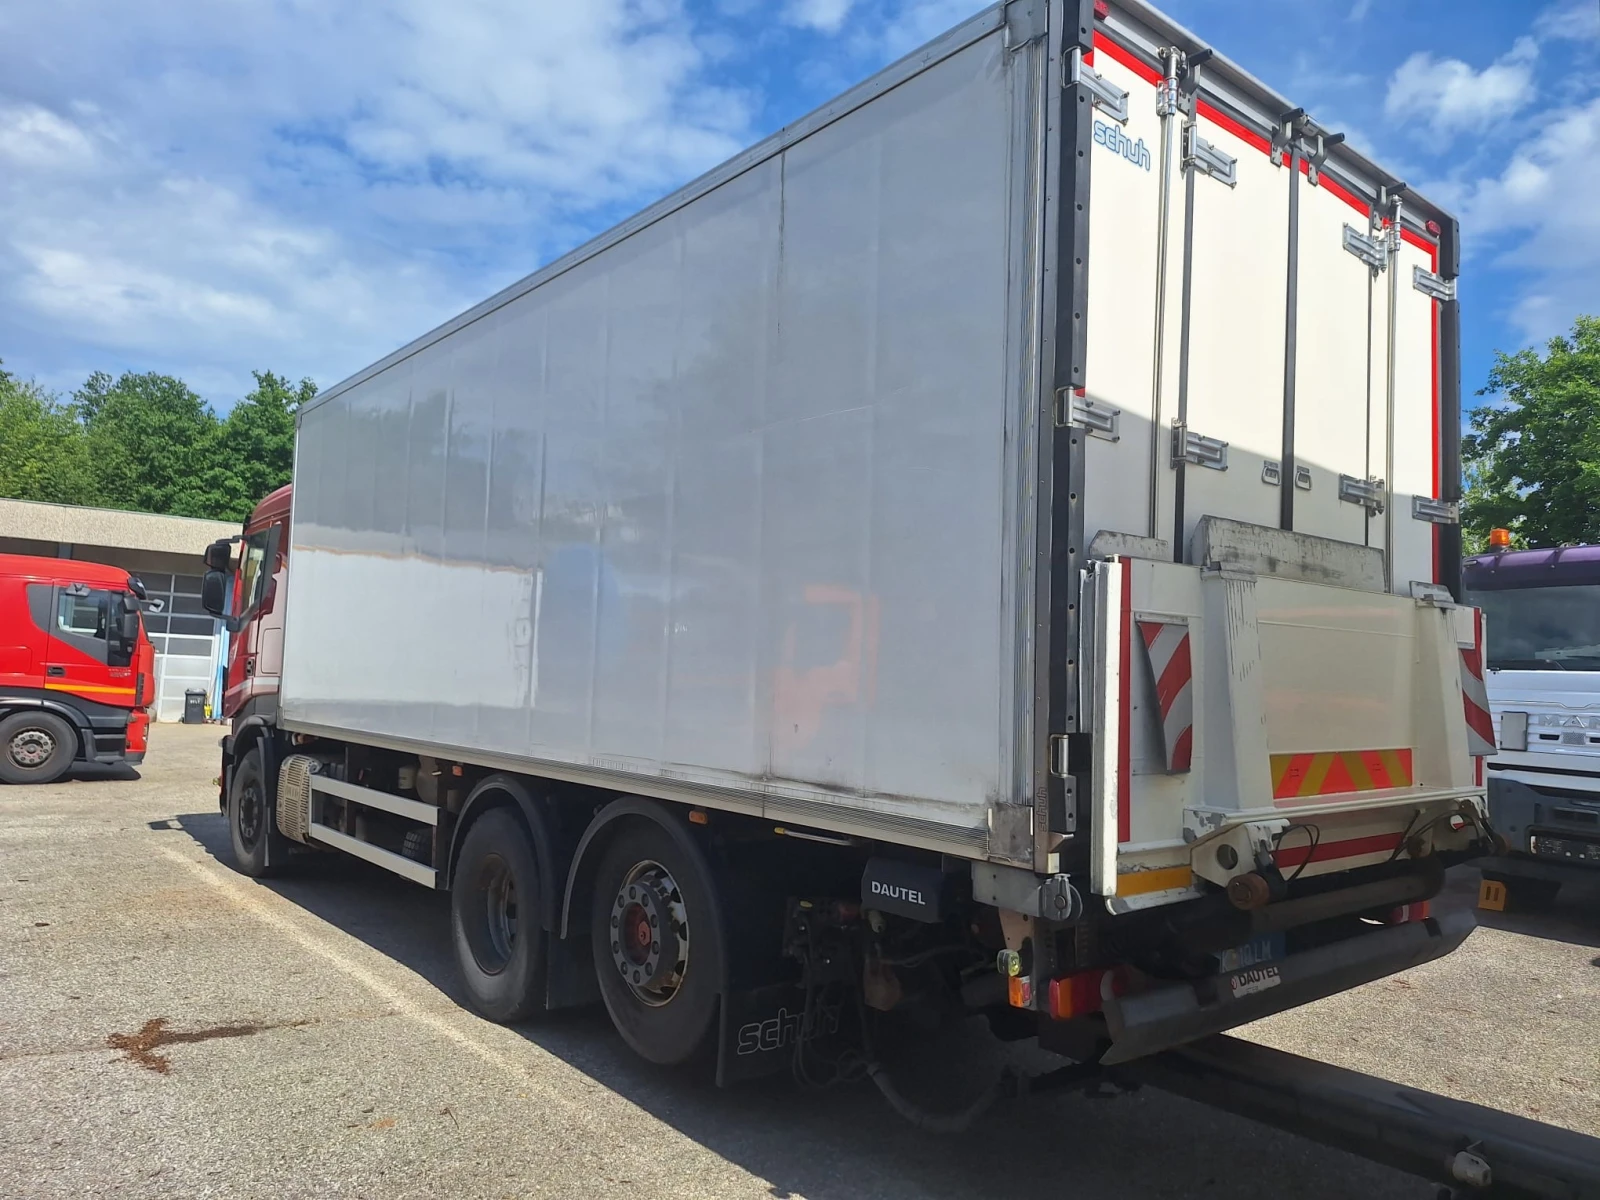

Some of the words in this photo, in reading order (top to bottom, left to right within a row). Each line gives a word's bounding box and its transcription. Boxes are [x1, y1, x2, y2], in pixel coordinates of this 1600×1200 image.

[1093, 120, 1151, 172] schuh
[1036, 786, 1048, 832] schuh
[871, 880, 926, 906] DAUTEL
[1238, 966, 1280, 987] DAUTEL
